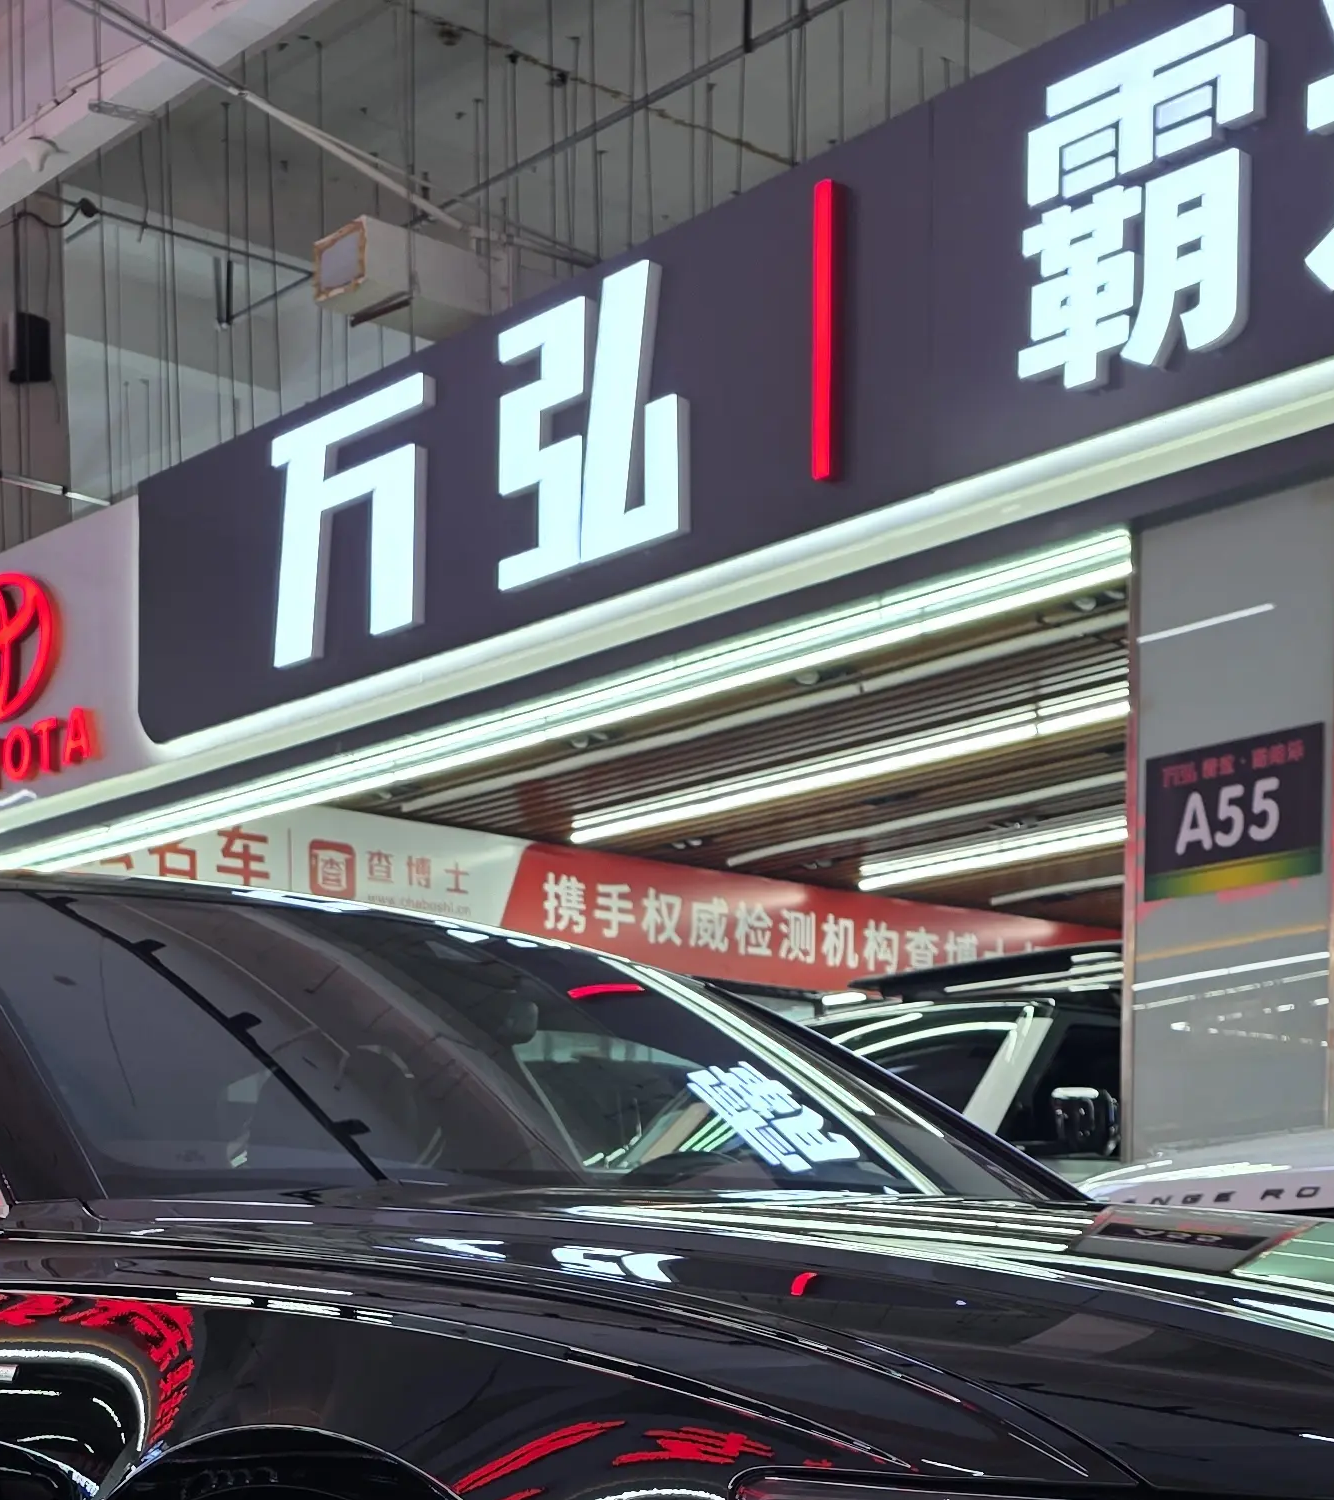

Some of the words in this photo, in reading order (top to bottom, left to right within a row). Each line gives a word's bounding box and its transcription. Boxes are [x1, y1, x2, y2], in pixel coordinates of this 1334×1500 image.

[271, 255, 689, 668] 万弘
[1175, 777, 1280, 855] A55
[366, 850, 469, 894] 查博士
[542, 871, 1050, 975] 携手权威检测机构查博
